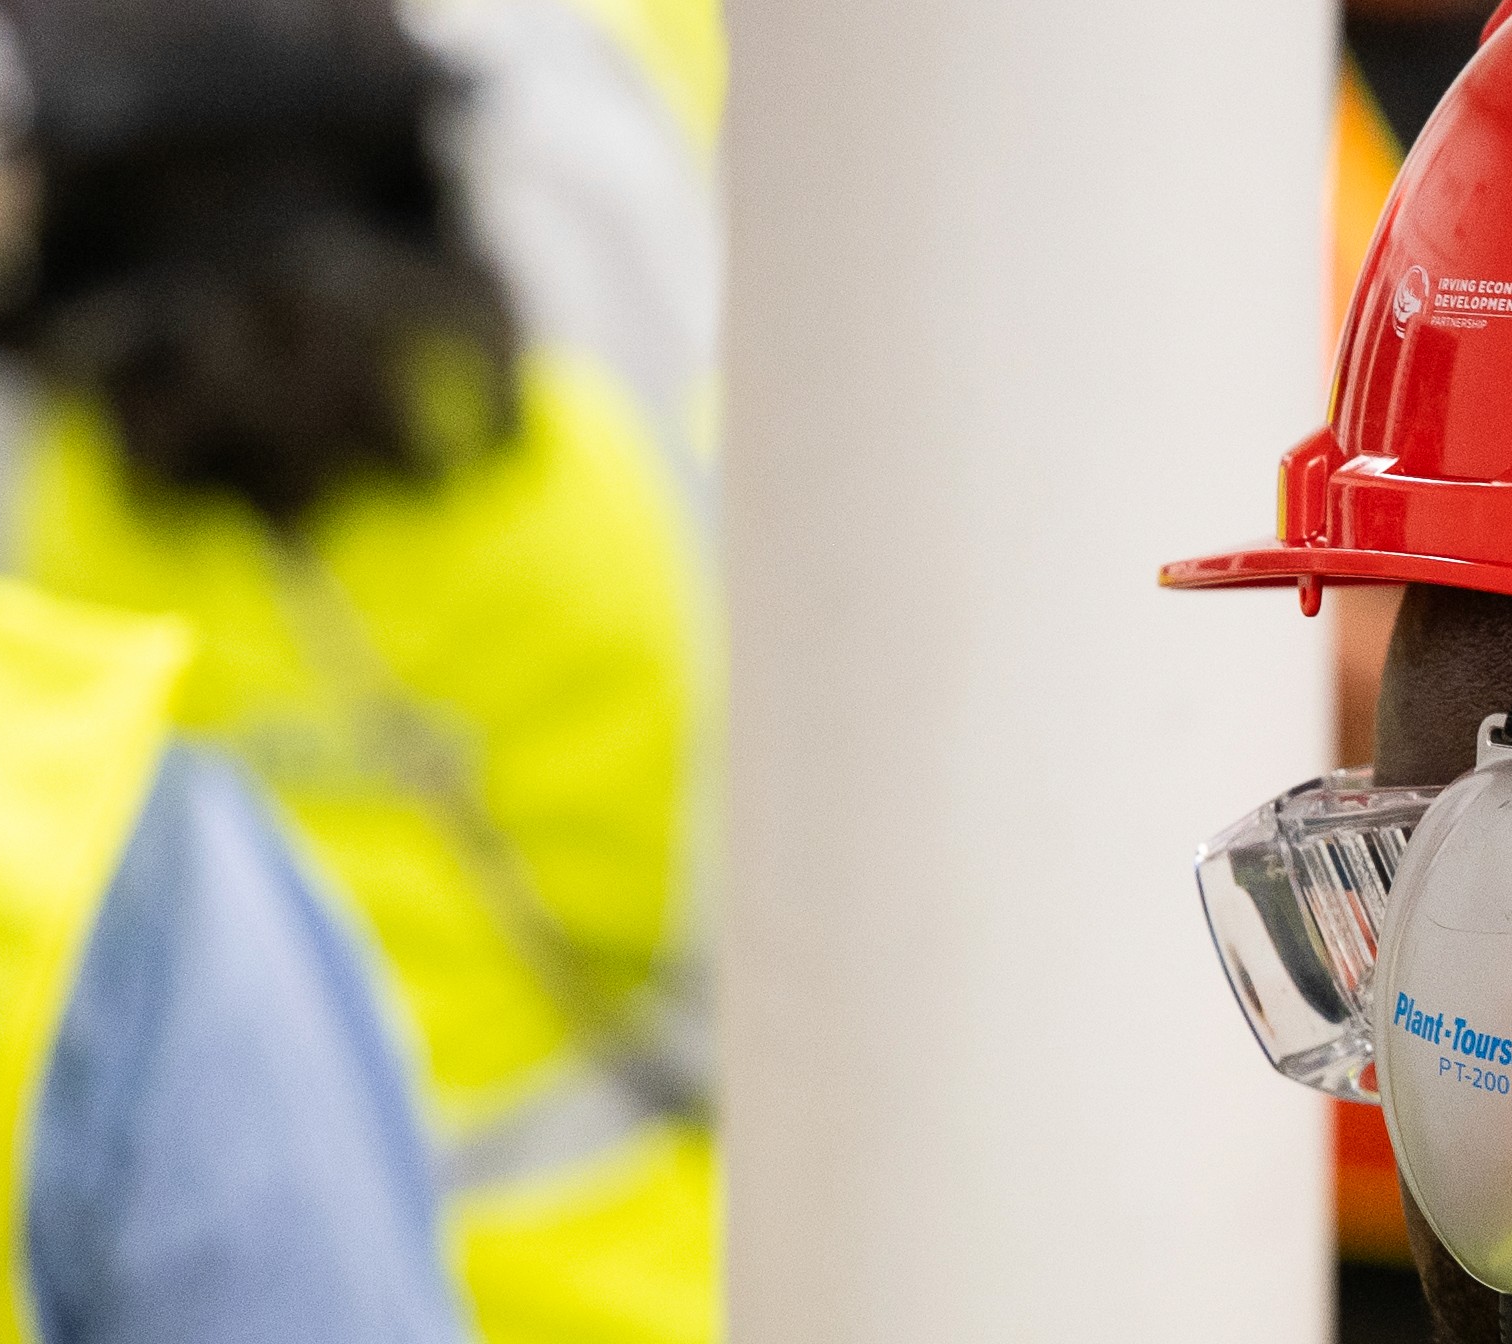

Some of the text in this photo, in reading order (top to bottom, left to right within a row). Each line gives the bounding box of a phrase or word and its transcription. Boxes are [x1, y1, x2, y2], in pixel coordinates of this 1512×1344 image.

[1439, 278, 1476, 292] IRVING
[1432, 316, 1487, 328] PARTNERSHIP
[1439, 1057, 1511, 1095] PT-200
